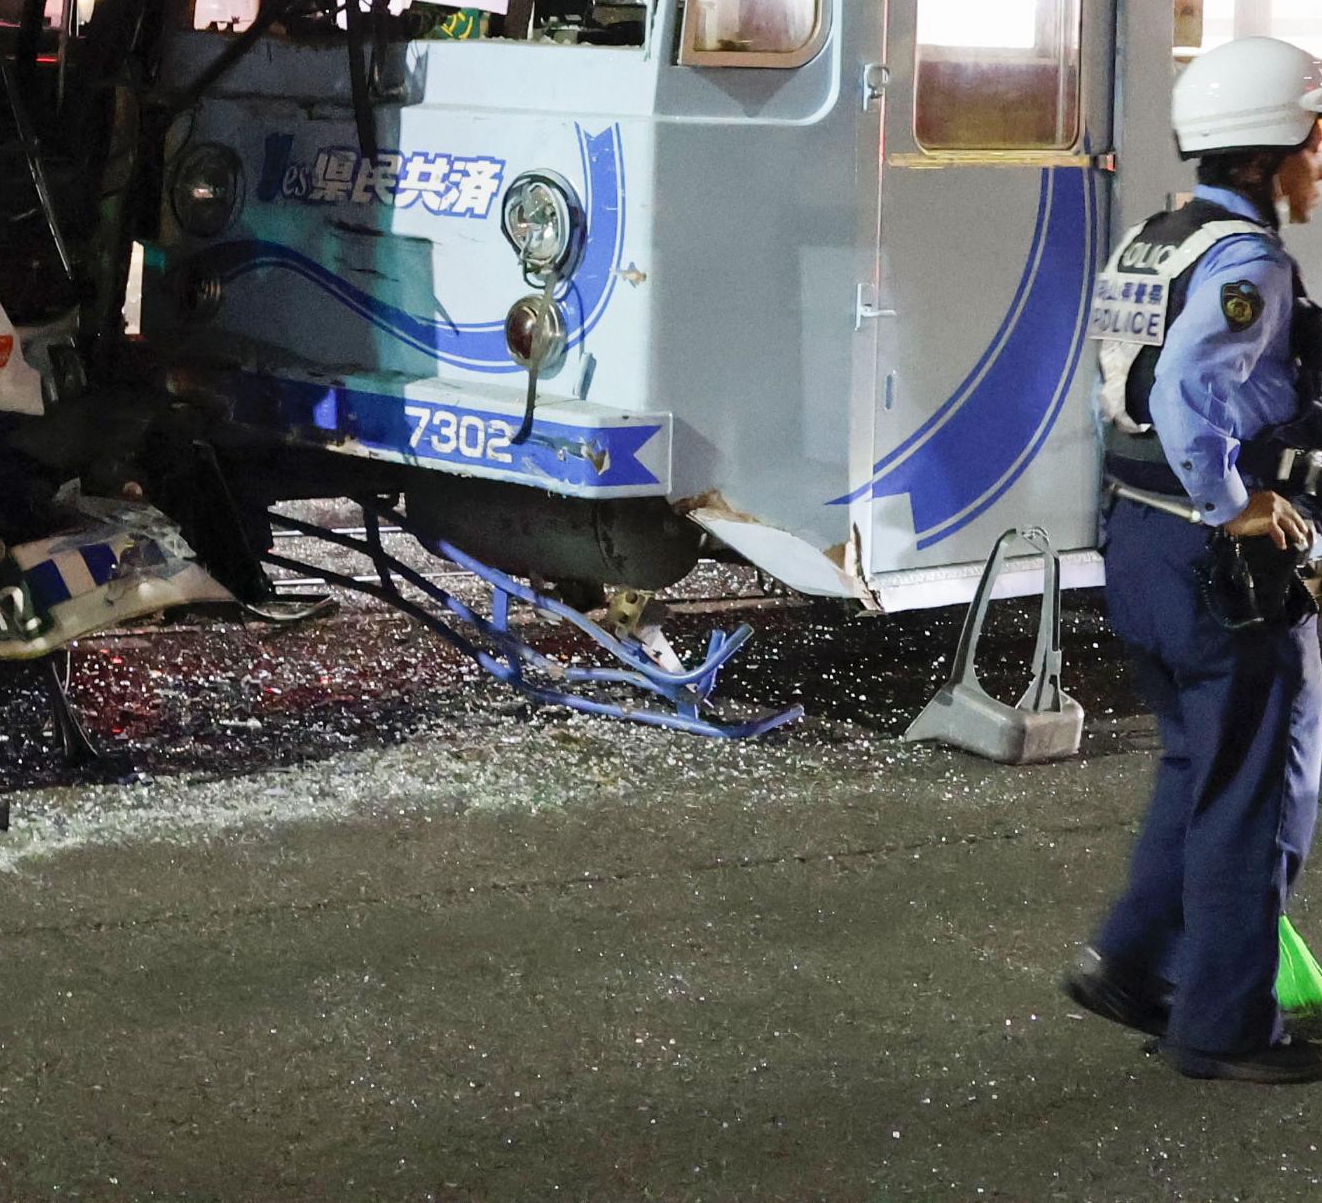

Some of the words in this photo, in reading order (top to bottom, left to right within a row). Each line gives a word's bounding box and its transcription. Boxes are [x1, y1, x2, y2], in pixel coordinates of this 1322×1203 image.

[306, 146, 505, 221] 県民共済
[1092, 307, 1161, 337] POLICE
[404, 405, 515, 464] 7302
